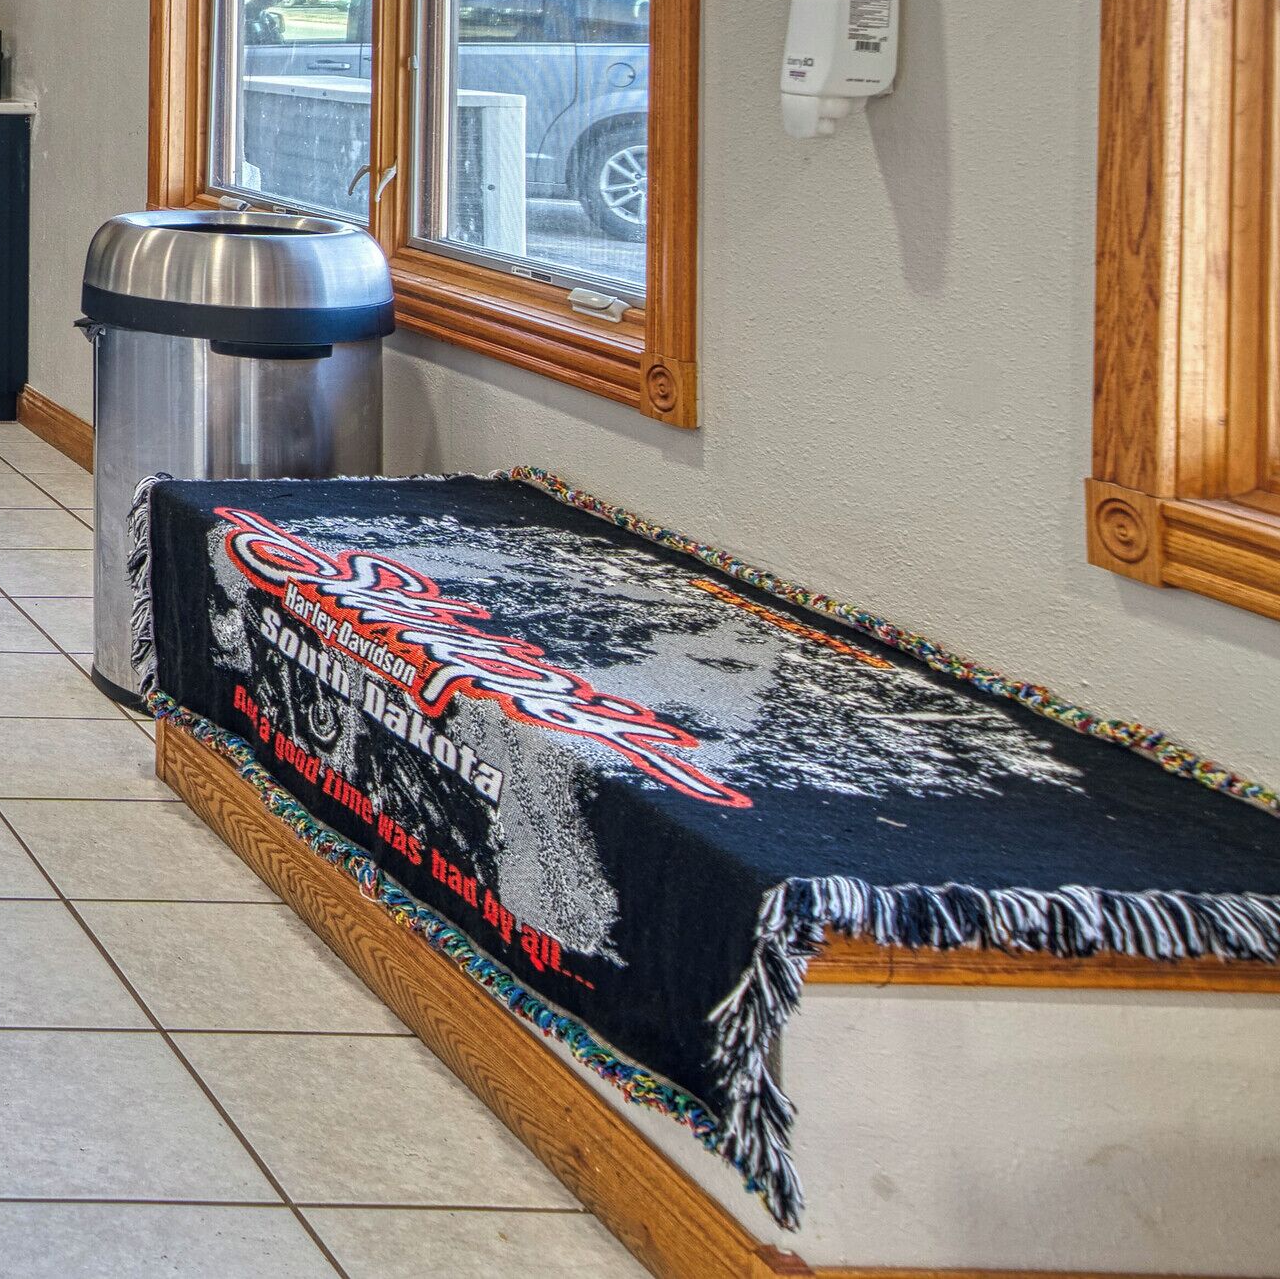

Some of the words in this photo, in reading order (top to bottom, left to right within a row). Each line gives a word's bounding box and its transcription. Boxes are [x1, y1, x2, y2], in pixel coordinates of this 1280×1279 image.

[259, 606, 351, 702] South
[362, 679, 505, 804] Dakota
[284, 582, 419, 688] Harley-Davidson
[259, 715, 271, 743] a
[274, 730, 321, 784] good
[322, 771, 375, 825] time
[377, 817, 424, 866] was
[432, 847, 479, 910] had
[483, 888, 517, 944] by
